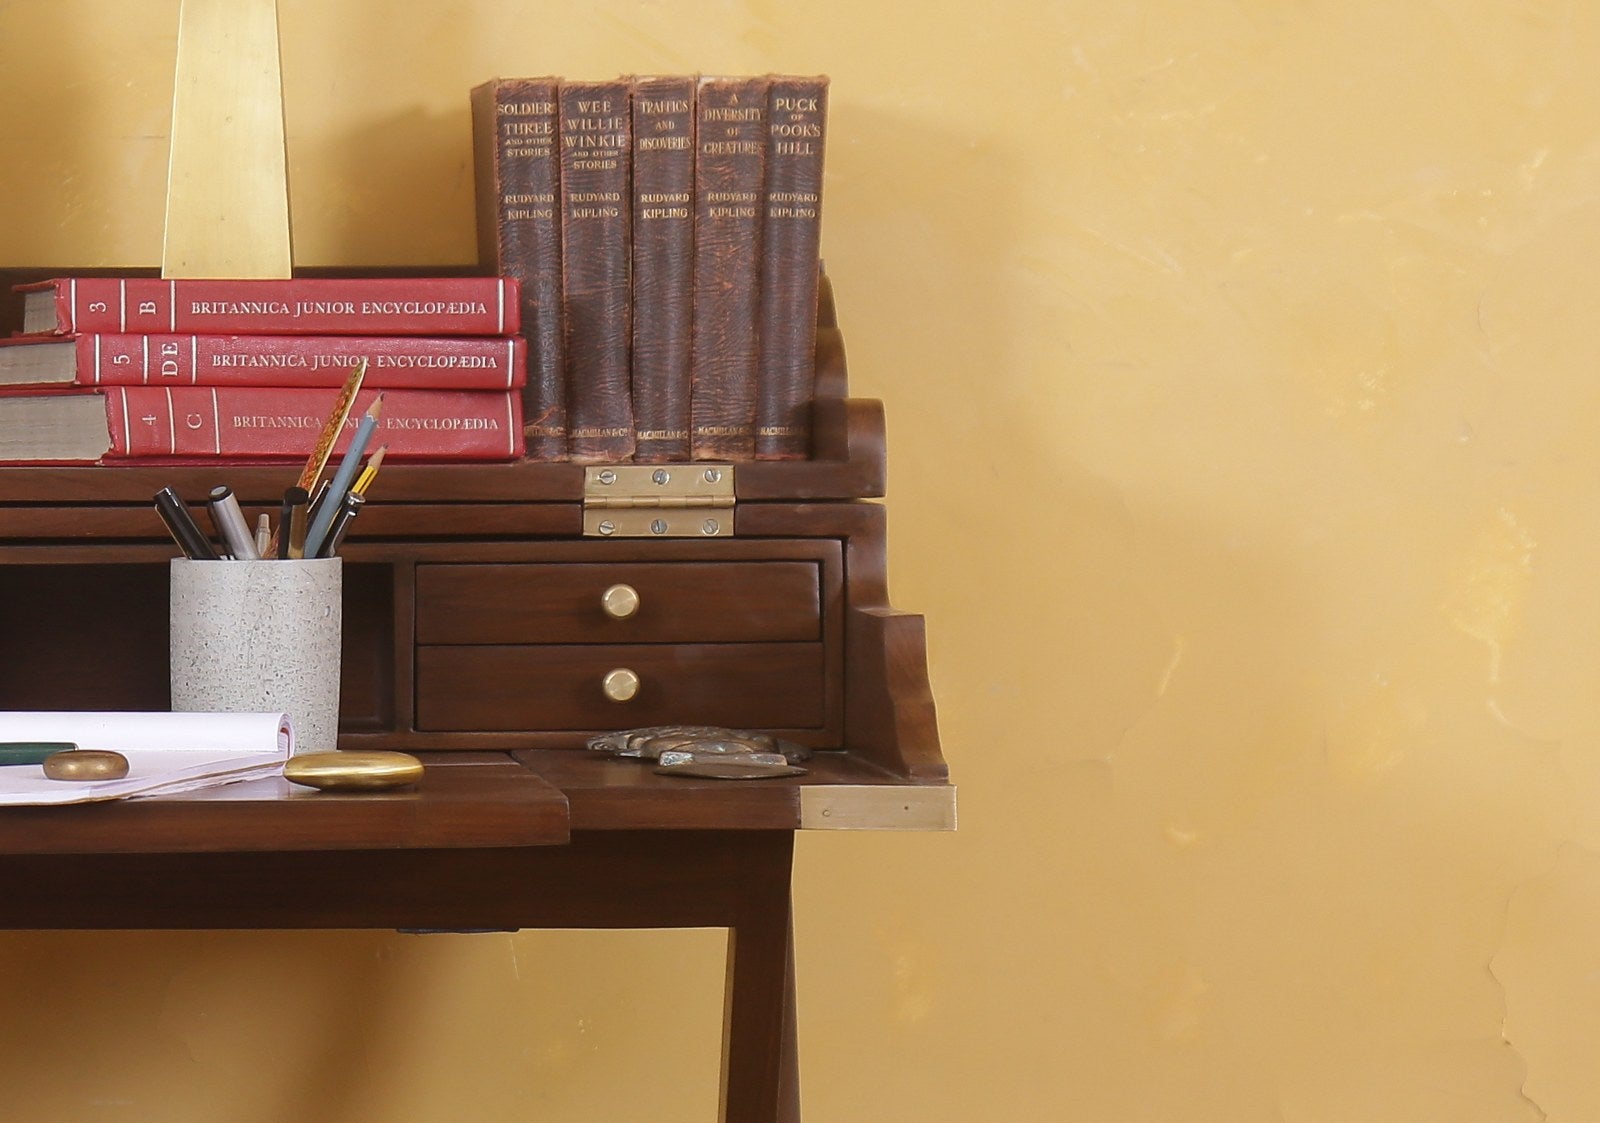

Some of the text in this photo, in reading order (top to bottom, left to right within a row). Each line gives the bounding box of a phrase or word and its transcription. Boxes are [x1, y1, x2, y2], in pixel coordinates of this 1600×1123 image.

[729, 93, 739, 105] A
[775, 98, 818, 111] PUCK
[578, 101, 612, 113] WEE
[640, 100, 689, 114] TRAFFICS
[704, 108, 761, 121] DIVERSITY
[504, 122, 554, 135] THREE
[567, 118, 624, 130] WILLIE
[656, 120, 675, 130] AND
[771, 123, 821, 137] POOK'S
[564, 134, 626, 147] WINKIE
[639, 136, 691, 150] DISCOVERIES
[507, 148, 551, 157] STORIES
[776, 141, 814, 155] HILL
[573, 160, 617, 170] STORIES
[505, 194, 555, 204] RUDYARD
[570, 192, 620, 202] RUDYARD
[641, 193, 690, 203] RUDYARD
[707, 192, 757, 201] RUDYARD
[769, 193, 818, 202] RUDYARD
[508, 208, 553, 220] KIPLING
[572, 207, 619, 218] KIPLING
[643, 207, 689, 219] KIPLING
[709, 207, 755, 217] KIPLING
[769, 208, 816, 218] KIPLING
[89, 302, 107, 313] 3
[139, 301, 157, 315] B
[191, 301, 488, 317] BRITANNICA JUNIOR ENCYCLOPÆDIA
[113, 354, 131, 365] 5
[212, 354, 308, 367] BRITANNICA
[376, 355, 498, 368] ENCYCLOPÆDIA
[141, 414, 157, 426] 4
[186, 412, 203, 430] C
[233, 415, 322, 428] BRITANNICA
[386, 417, 499, 430] ENCYCLOPÆDIA
